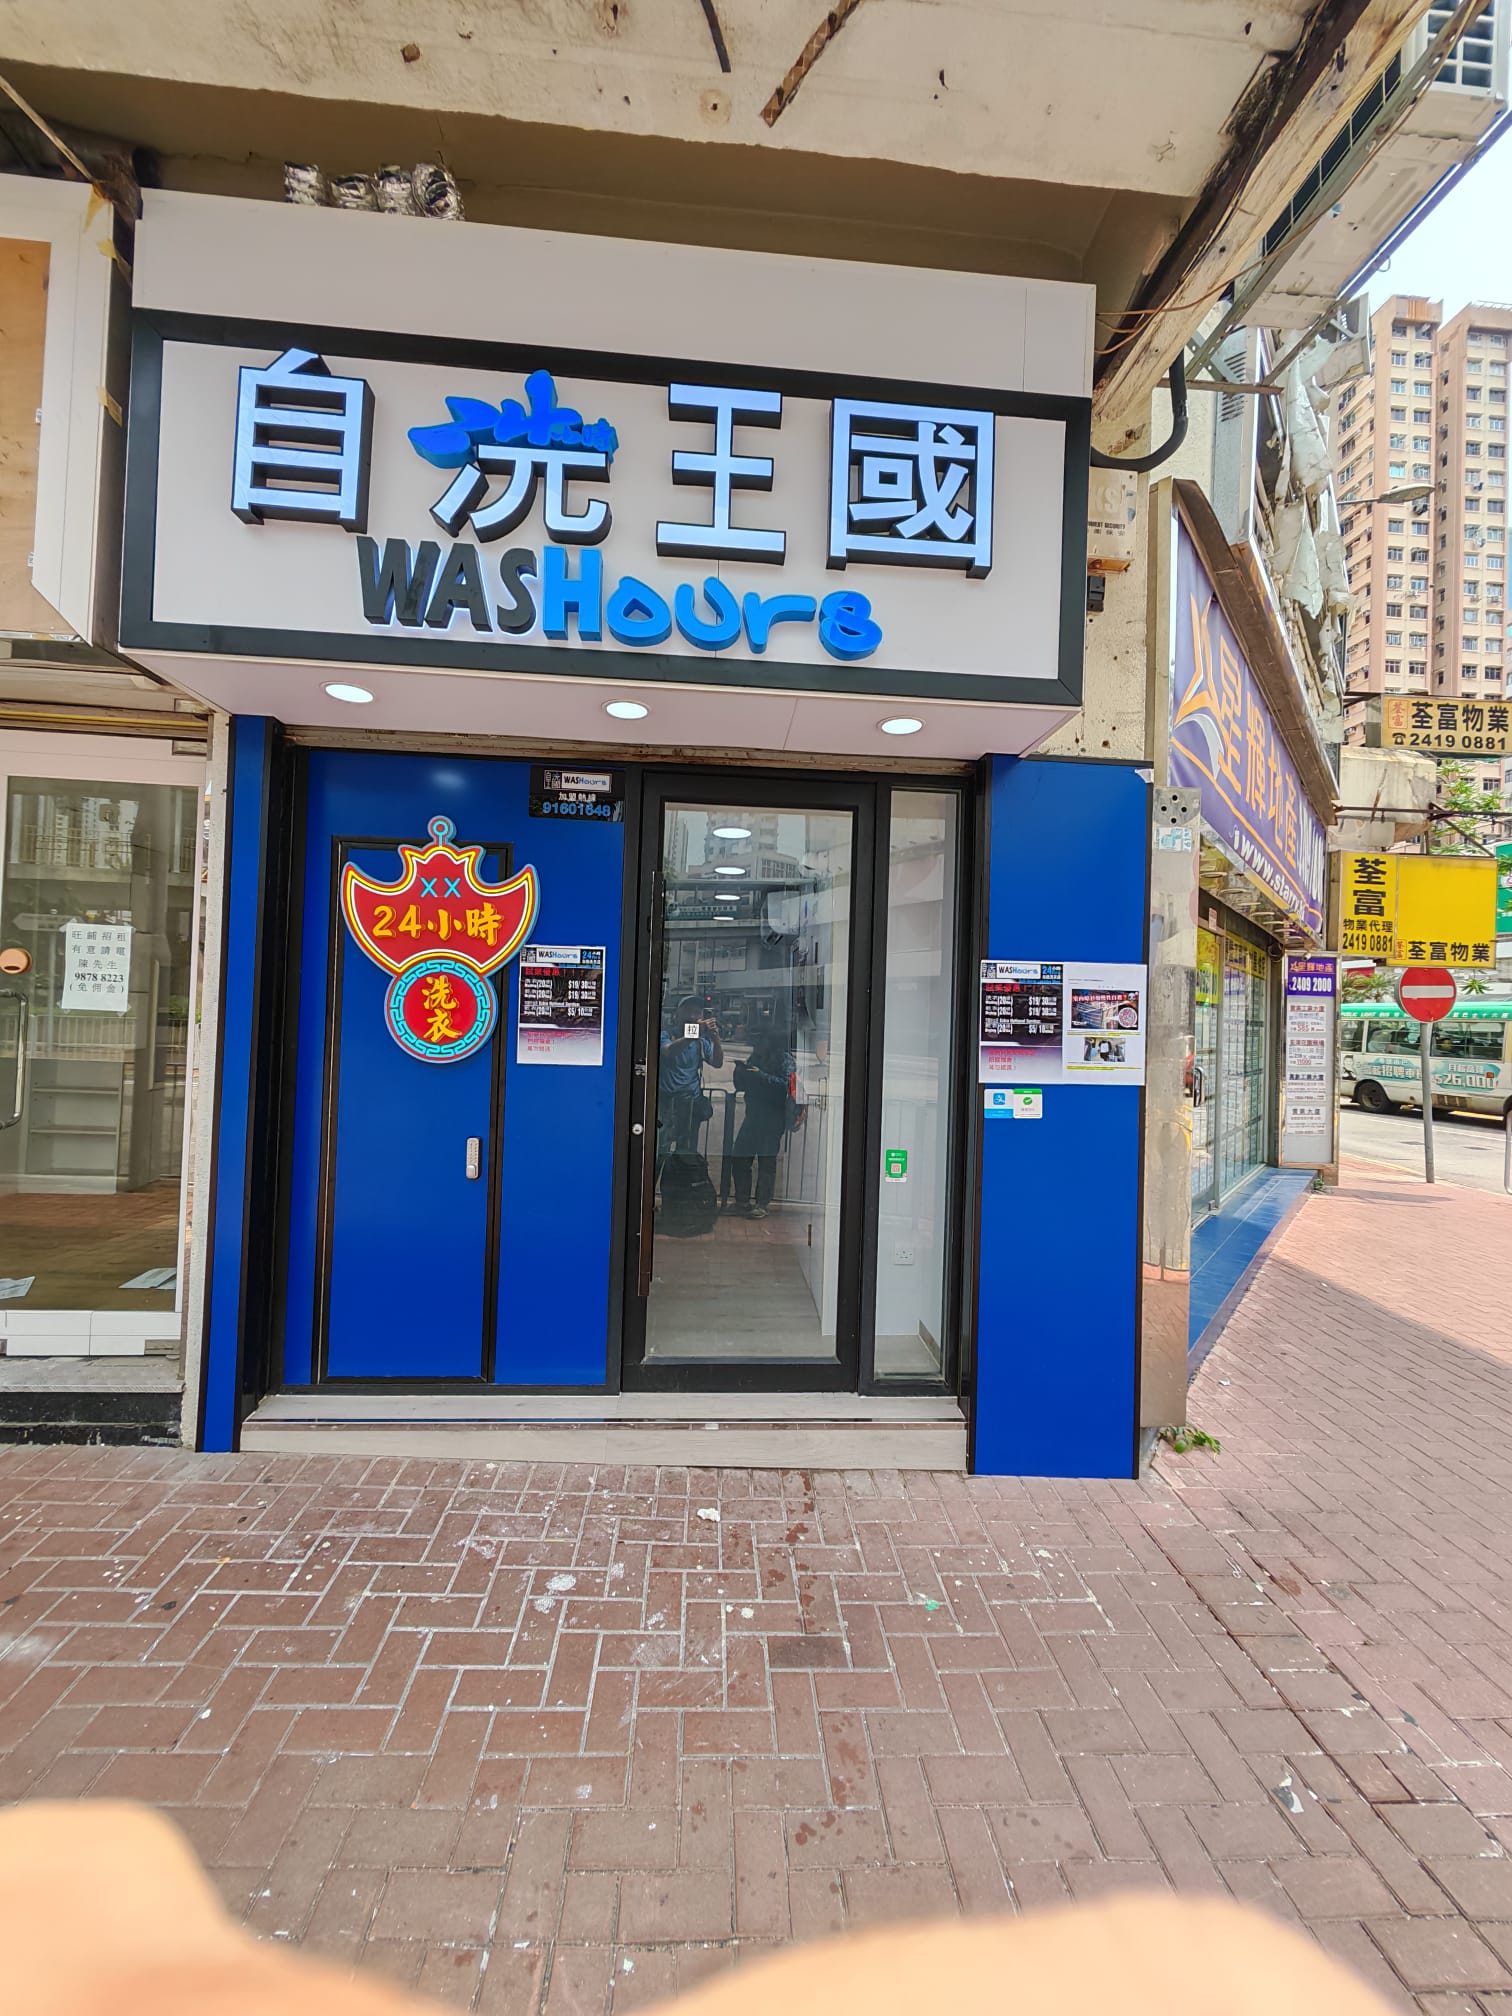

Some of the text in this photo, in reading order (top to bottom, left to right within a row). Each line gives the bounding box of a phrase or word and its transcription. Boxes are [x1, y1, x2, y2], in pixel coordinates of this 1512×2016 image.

[231, 347, 995, 579] 自洗王國
[357, 536, 883, 661] WASHours
[1411, 701, 1509, 733] 荃富物業
[1409, 733, 1506, 750] 2419 0881
[1352, 857, 1388, 916] 荃富
[372, 902, 502, 946] 24小時
[1343, 918, 1393, 933] 物業代理
[1342, 932, 1393, 952] 2419 0881
[1407, 940, 1490, 963] 荃富物業
[74, 972, 124, 983] 9878 8223
[1292, 976, 1332, 992] 2409 2000
[421, 976, 462, 1042] 洗衣
